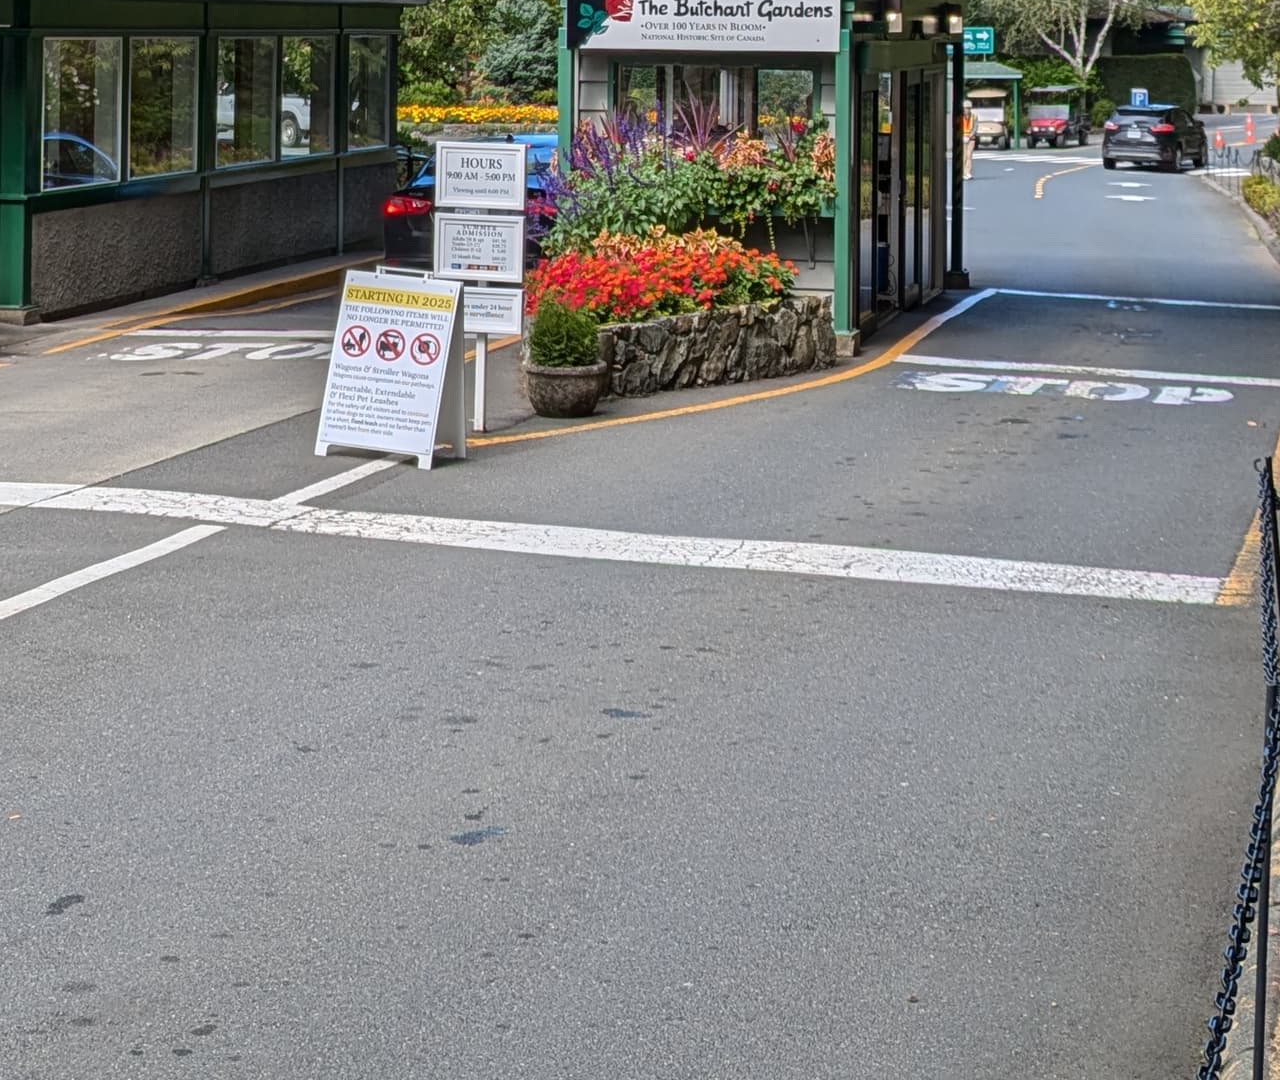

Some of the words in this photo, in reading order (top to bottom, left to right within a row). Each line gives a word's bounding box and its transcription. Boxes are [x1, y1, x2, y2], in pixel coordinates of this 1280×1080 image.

[638, 0, 668, 16] The
[757, 0, 834, 22] Gardens
[672, 22, 687, 30] 100
[461, 157, 503, 170] HOURS
[448, 171, 462, 180] 9:00
[464, 172, 478, 180] AM
[485, 173, 500, 182] 5:00
[502, 173, 516, 182] PM
[453, 187, 473, 195] Viewing
[347, 288, 404, 304] STARTING
[406, 295, 420, 305] IN
[422, 297, 452, 309] 2025
[361, 306, 405, 317] FOLLOWING
[406, 311, 429, 319] ITEMS
[430, 313, 449, 322] WILL
[359, 315, 389, 325] LONGER
[401, 320, 444, 331] PERMITTED
[335, 363, 362, 374] Wagons
[363, 364, 371, 373] &
[372, 366, 400, 377] Stroller
[401, 370, 429, 380] Wagons
[375, 387, 416, 399] Extendable
[893, 372, 1235, 406] STOP
[338, 392, 355, 401] Flexi
[357, 394, 368, 403] Pet
[370, 396, 399, 406] Leashes
